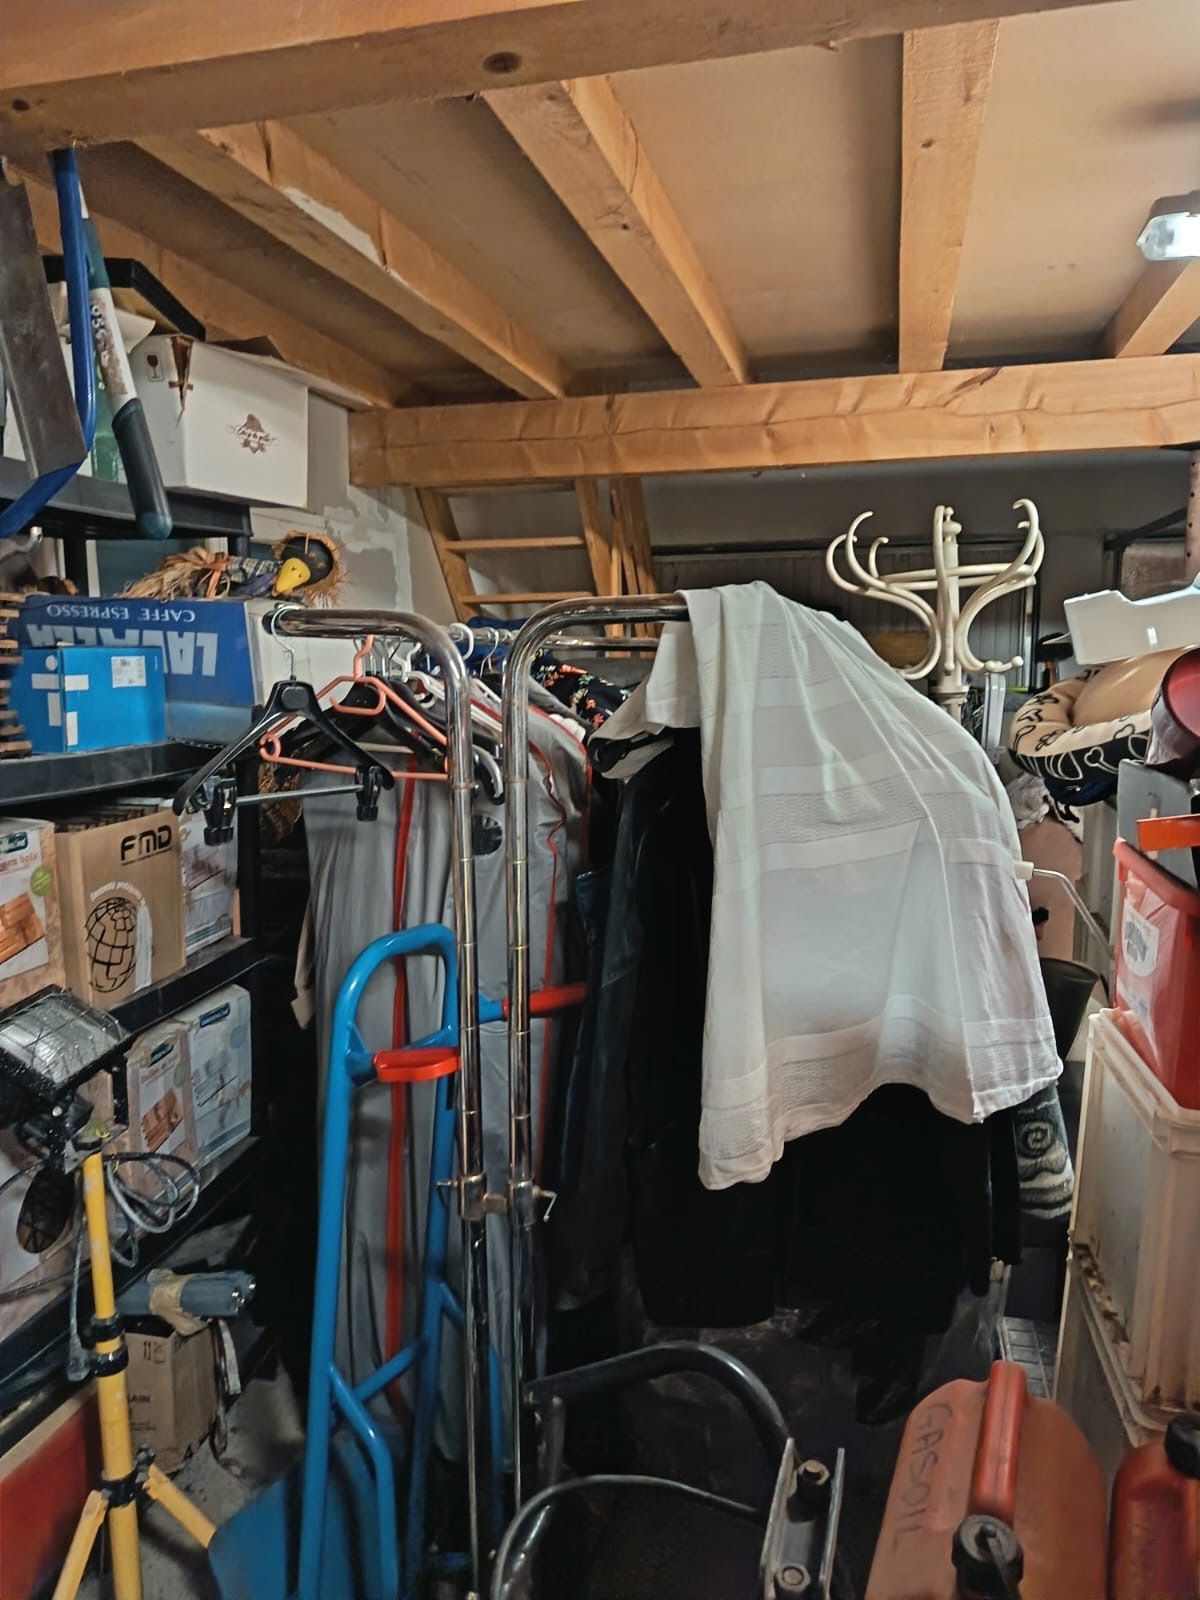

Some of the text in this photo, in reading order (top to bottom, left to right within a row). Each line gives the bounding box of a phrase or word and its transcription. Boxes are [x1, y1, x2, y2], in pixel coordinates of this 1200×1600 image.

[46, 604, 129, 620] ESPRESSO
[120, 825, 172, 860] FMD
[892, 1402, 954, 1552] GASOIL
